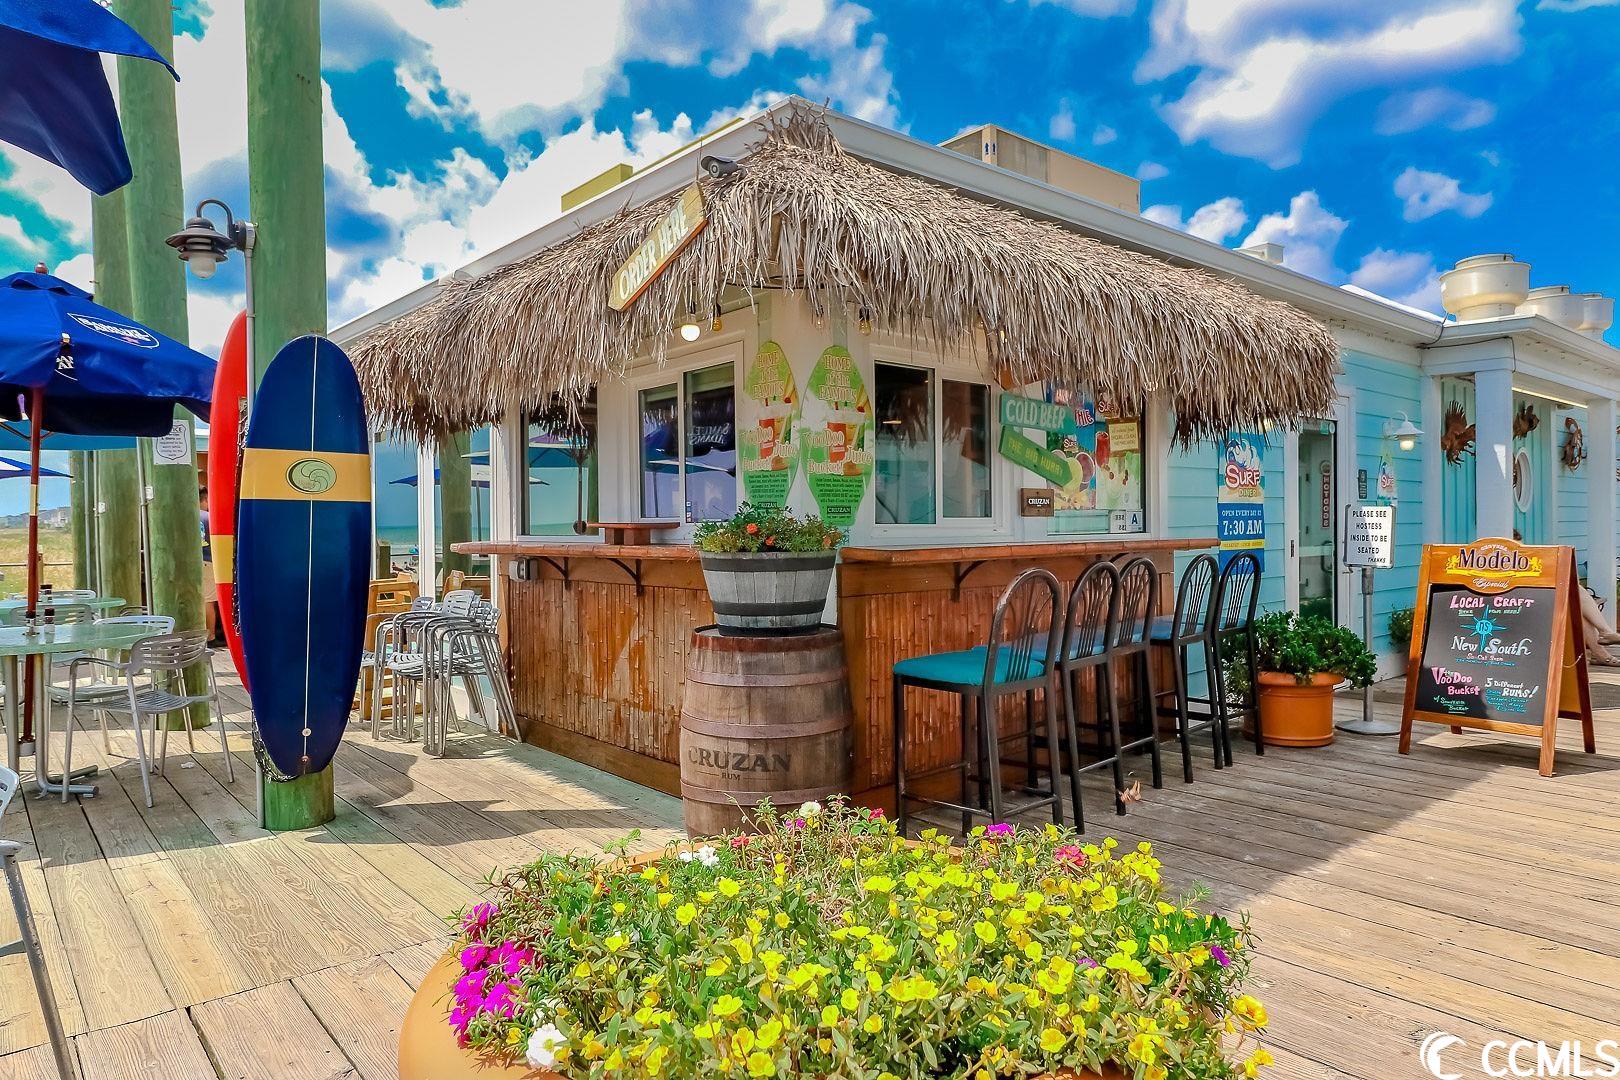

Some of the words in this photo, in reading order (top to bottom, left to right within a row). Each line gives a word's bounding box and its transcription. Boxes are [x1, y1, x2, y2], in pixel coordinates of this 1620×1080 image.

[619, 240, 657, 300] ORDER
[657, 199, 689, 259] HERE
[824, 354, 852, 371] HOME
[1006, 400, 1037, 425] COLD
[1039, 402, 1066, 429] BEER
[1226, 464, 1260, 488] SURF
[1131, 513, 1138, 525] A
[1352, 510, 1374, 518] PLEASE
[1375, 510, 1387, 518] SEE
[1222, 520, 1245, 536] 7:30
[1246, 519, 1263, 535] AM
[1356, 522, 1382, 530] HOSTESS
[1350, 534, 1370, 542] INSIDE
[1357, 546, 1380, 554] SEATED
[1458, 548, 1529, 571] Modelo
[1472, 578, 1510, 589] Especial
[1450, 595, 1485, 609] LOCAL
[1493, 596, 1535, 608] CRAFT
[1451, 636, 1479, 652] New
[1484, 638, 1533, 656] South
[1484, 677, 1493, 687] 5
[688, 745, 791, 773] CRUZAN
[721, 773, 741, 781] RUM
